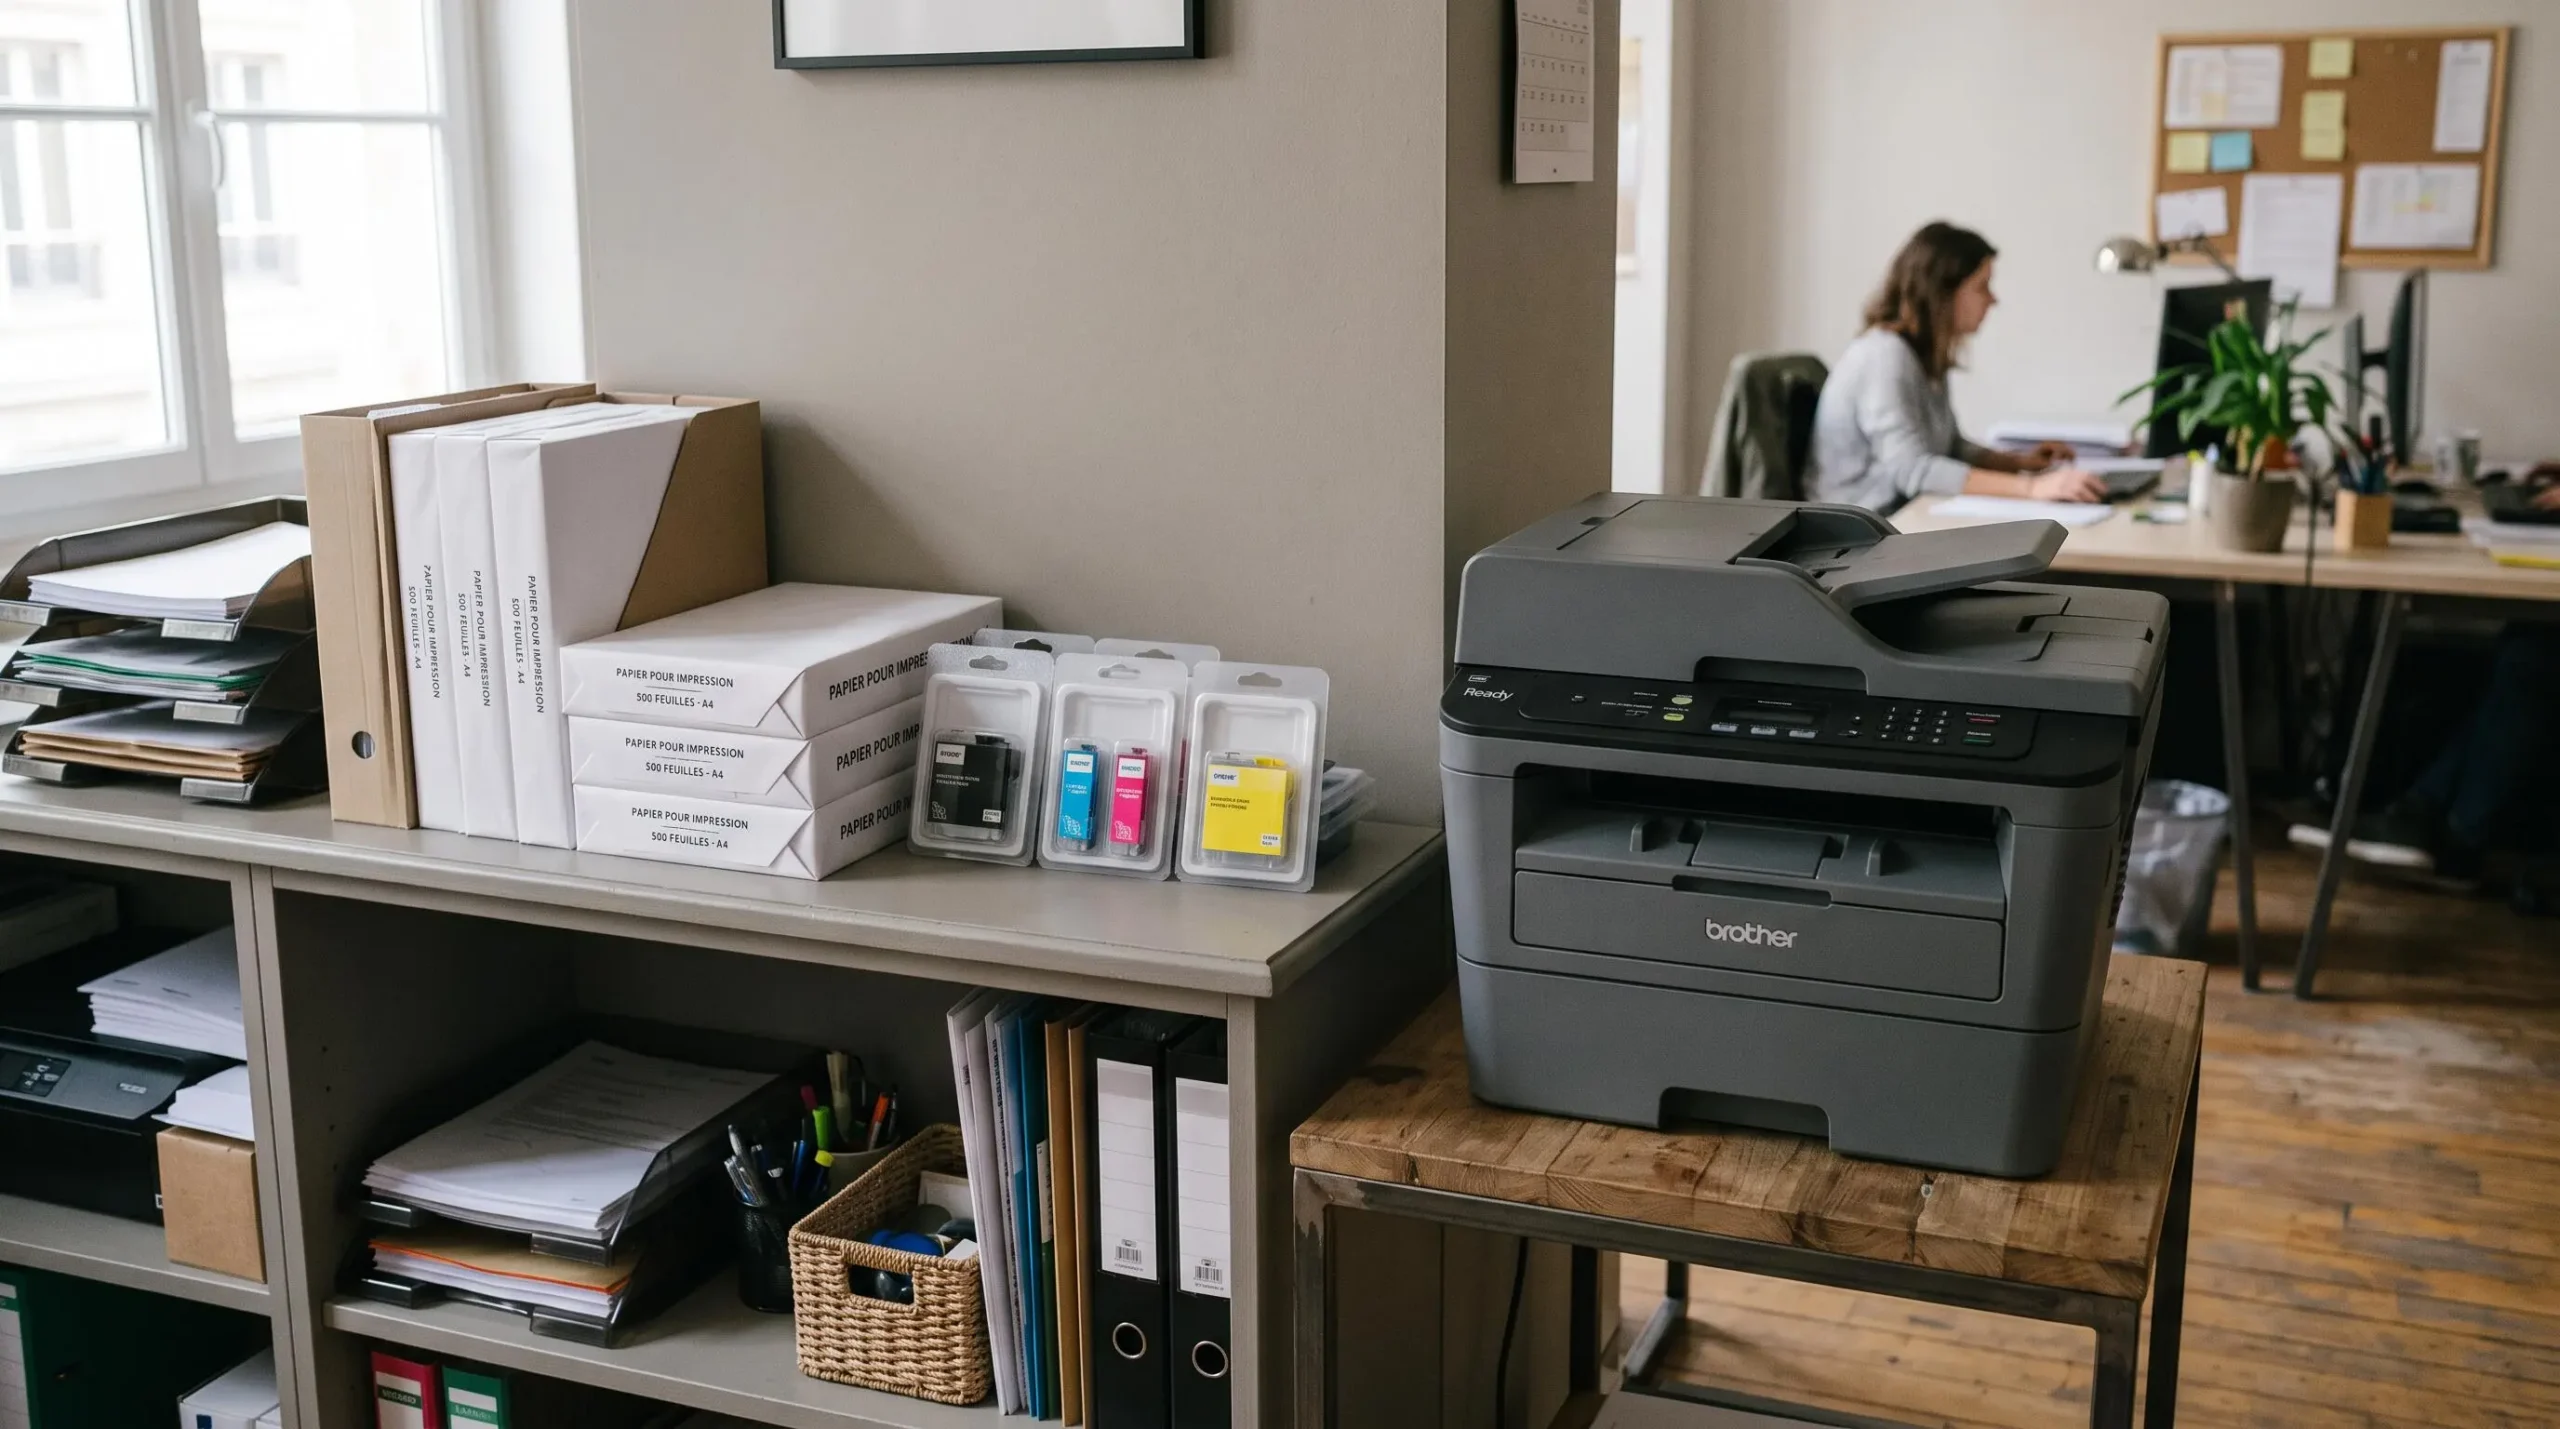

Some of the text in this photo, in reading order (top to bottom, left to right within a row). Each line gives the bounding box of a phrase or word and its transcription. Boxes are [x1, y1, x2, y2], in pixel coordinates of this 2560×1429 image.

[528, 575, 538, 613] PAPIER
[427, 604, 436, 634] POUR
[512, 598, 520, 617] 500
[473, 570, 491, 707] PAPIER POUR IMPRESSION
[514, 620, 524, 663] FEUILLES
[531, 616, 540, 646] POUR
[517, 671, 525, 684] A4
[616, 668, 734, 688] PAPIER POUR IMPRESSION
[829, 674, 865, 700] PAPIER
[867, 664, 894, 688] POUR
[636, 693, 652, 703] 500
[655, 694, 695, 707] FEUILLES
[702, 699, 714, 709] A4
[1463, 687, 1514, 701] Ready
[625, 737, 744, 758] PAPIER POUR IMPRESSION
[836, 744, 872, 771] PAPIER
[874, 732, 900, 754] POUR
[645, 762, 661, 772] 500
[664, 764, 704, 777] FEUILLES
[711, 769, 724, 779] A4
[632, 807, 748, 830] PAPIER POUR IMPRESSION
[840, 807, 875, 840] PAPIER
[876, 799, 902, 824] POUR
[652, 832, 667, 842] 500
[670, 833, 709, 847] FEUILLES
[716, 839, 728, 849] A4
[1706, 918, 1798, 948] brother
